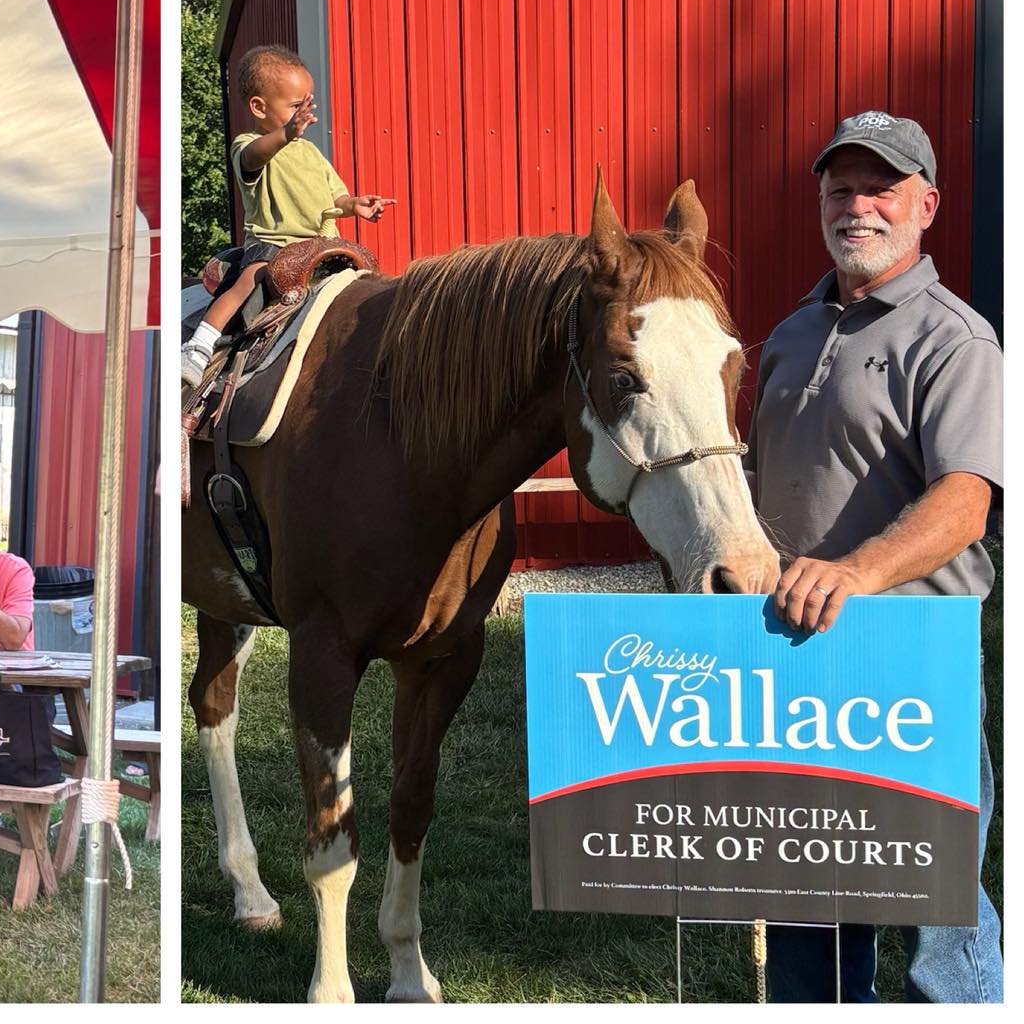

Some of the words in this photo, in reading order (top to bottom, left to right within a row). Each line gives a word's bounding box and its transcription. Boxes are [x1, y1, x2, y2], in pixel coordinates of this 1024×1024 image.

[604, 633, 720, 692] Chrissy
[576, 667, 934, 752] Wallace
[635, 803, 696, 827] FOR
[703, 805, 877, 832] MUNICIPAL
[581, 832, 705, 861] CLERK
[715, 836, 765, 862] OF
[777, 837, 934, 868] COURTS
[662, 883, 683, 892] Chrissy
[809, 889, 830, 897] County
